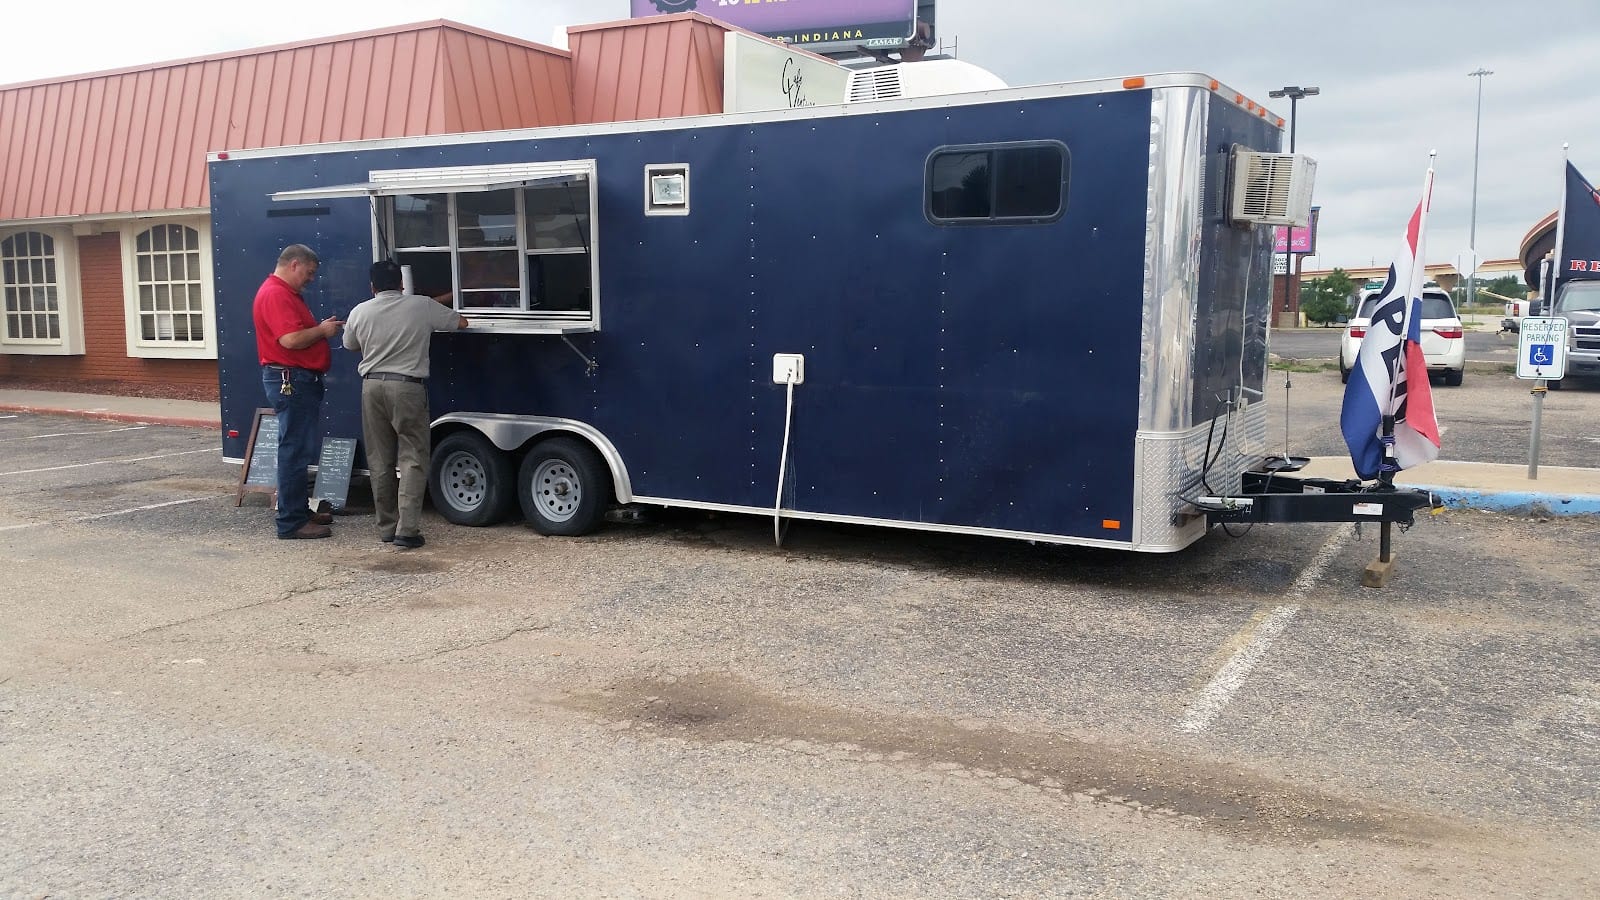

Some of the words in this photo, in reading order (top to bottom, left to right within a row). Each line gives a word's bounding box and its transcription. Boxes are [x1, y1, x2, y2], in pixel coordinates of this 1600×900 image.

[794, 30, 863, 43] INDIANA
[867, 37, 902, 46] LAMAR
[1523, 322, 1565, 332] RESERVED
[1526, 333, 1560, 342] PARKING
